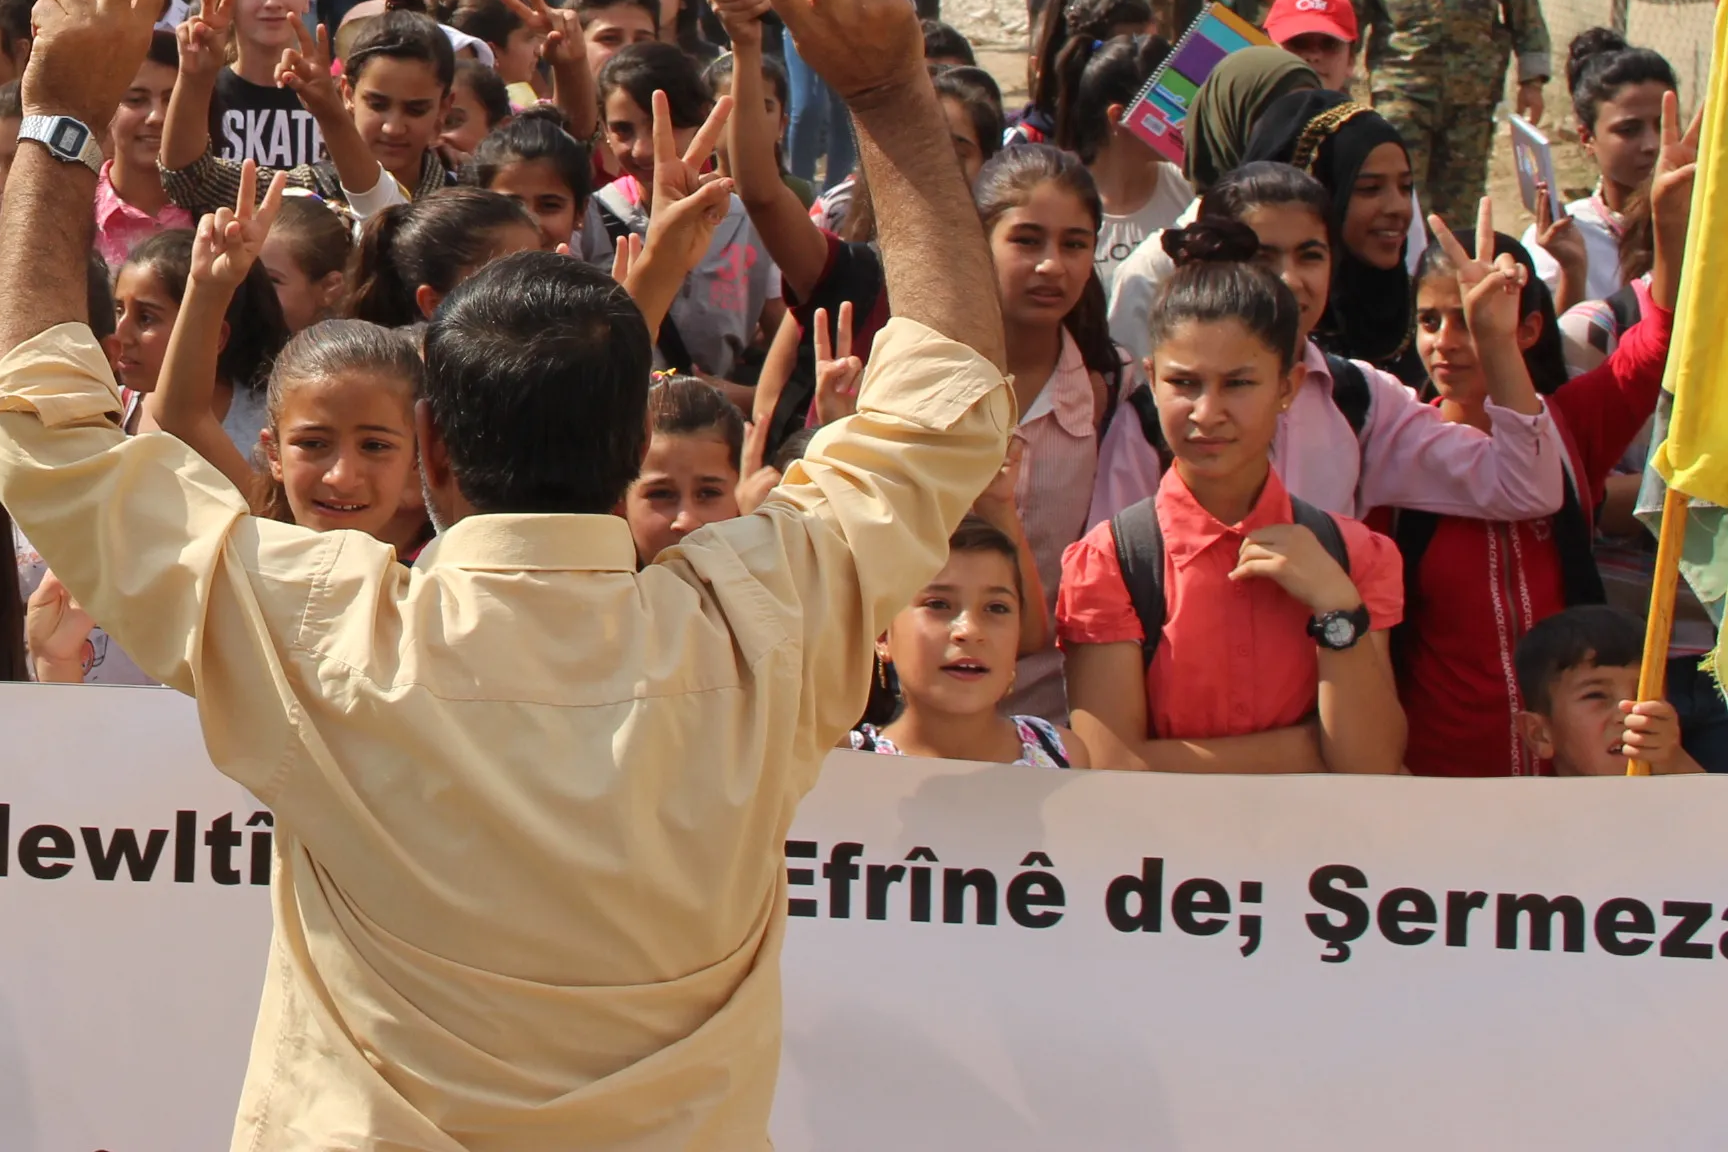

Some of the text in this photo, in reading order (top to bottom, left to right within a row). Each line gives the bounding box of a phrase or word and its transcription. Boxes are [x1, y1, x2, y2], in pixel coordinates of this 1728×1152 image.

[784, 839, 1066, 929] Efrînê
[1105, 857, 1263, 958] de;
[1305, 864, 1728, 963] Şermez
